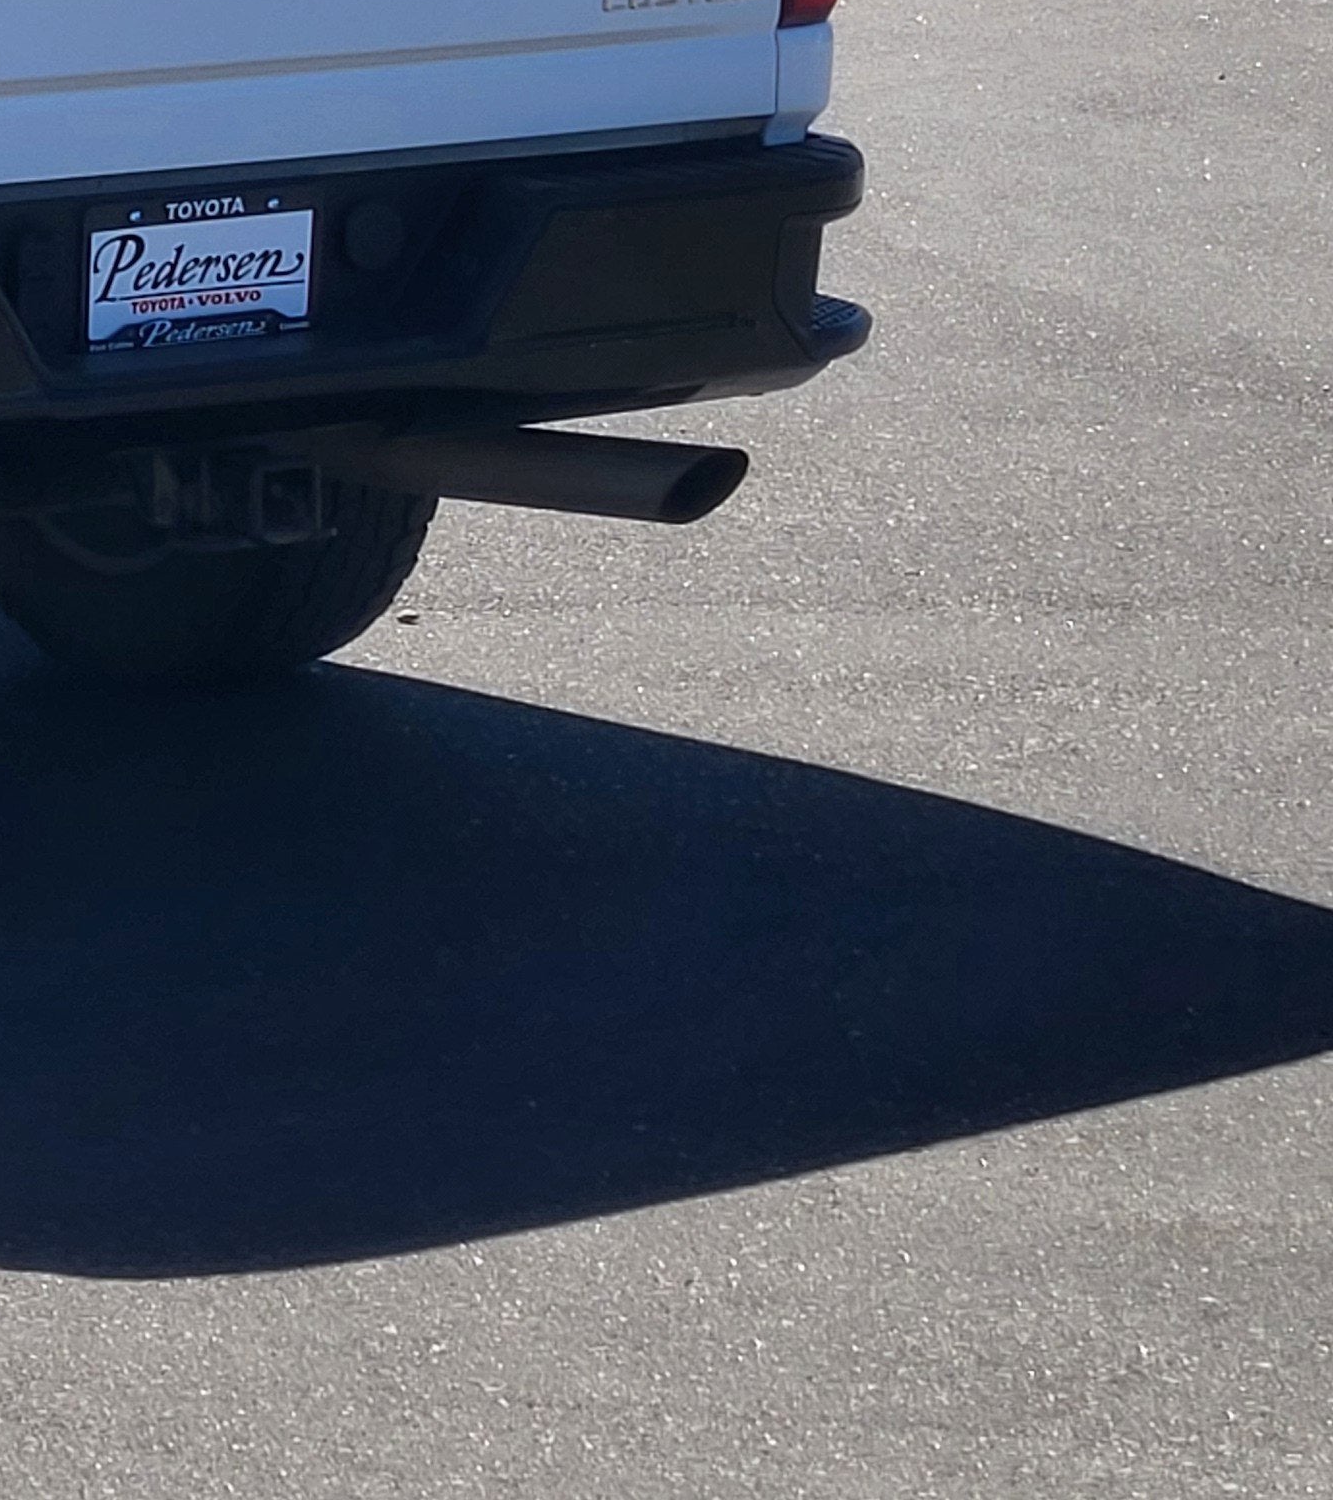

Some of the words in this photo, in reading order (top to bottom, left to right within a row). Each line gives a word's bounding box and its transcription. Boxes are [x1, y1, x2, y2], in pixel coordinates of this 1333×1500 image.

[166, 197, 245, 221] TOYOTA
[93, 234, 304, 303] Pedersen
[131, 296, 186, 315] TOYOTA
[197, 289, 262, 307] VOLVO
[138, 319, 268, 347] Pedersen
